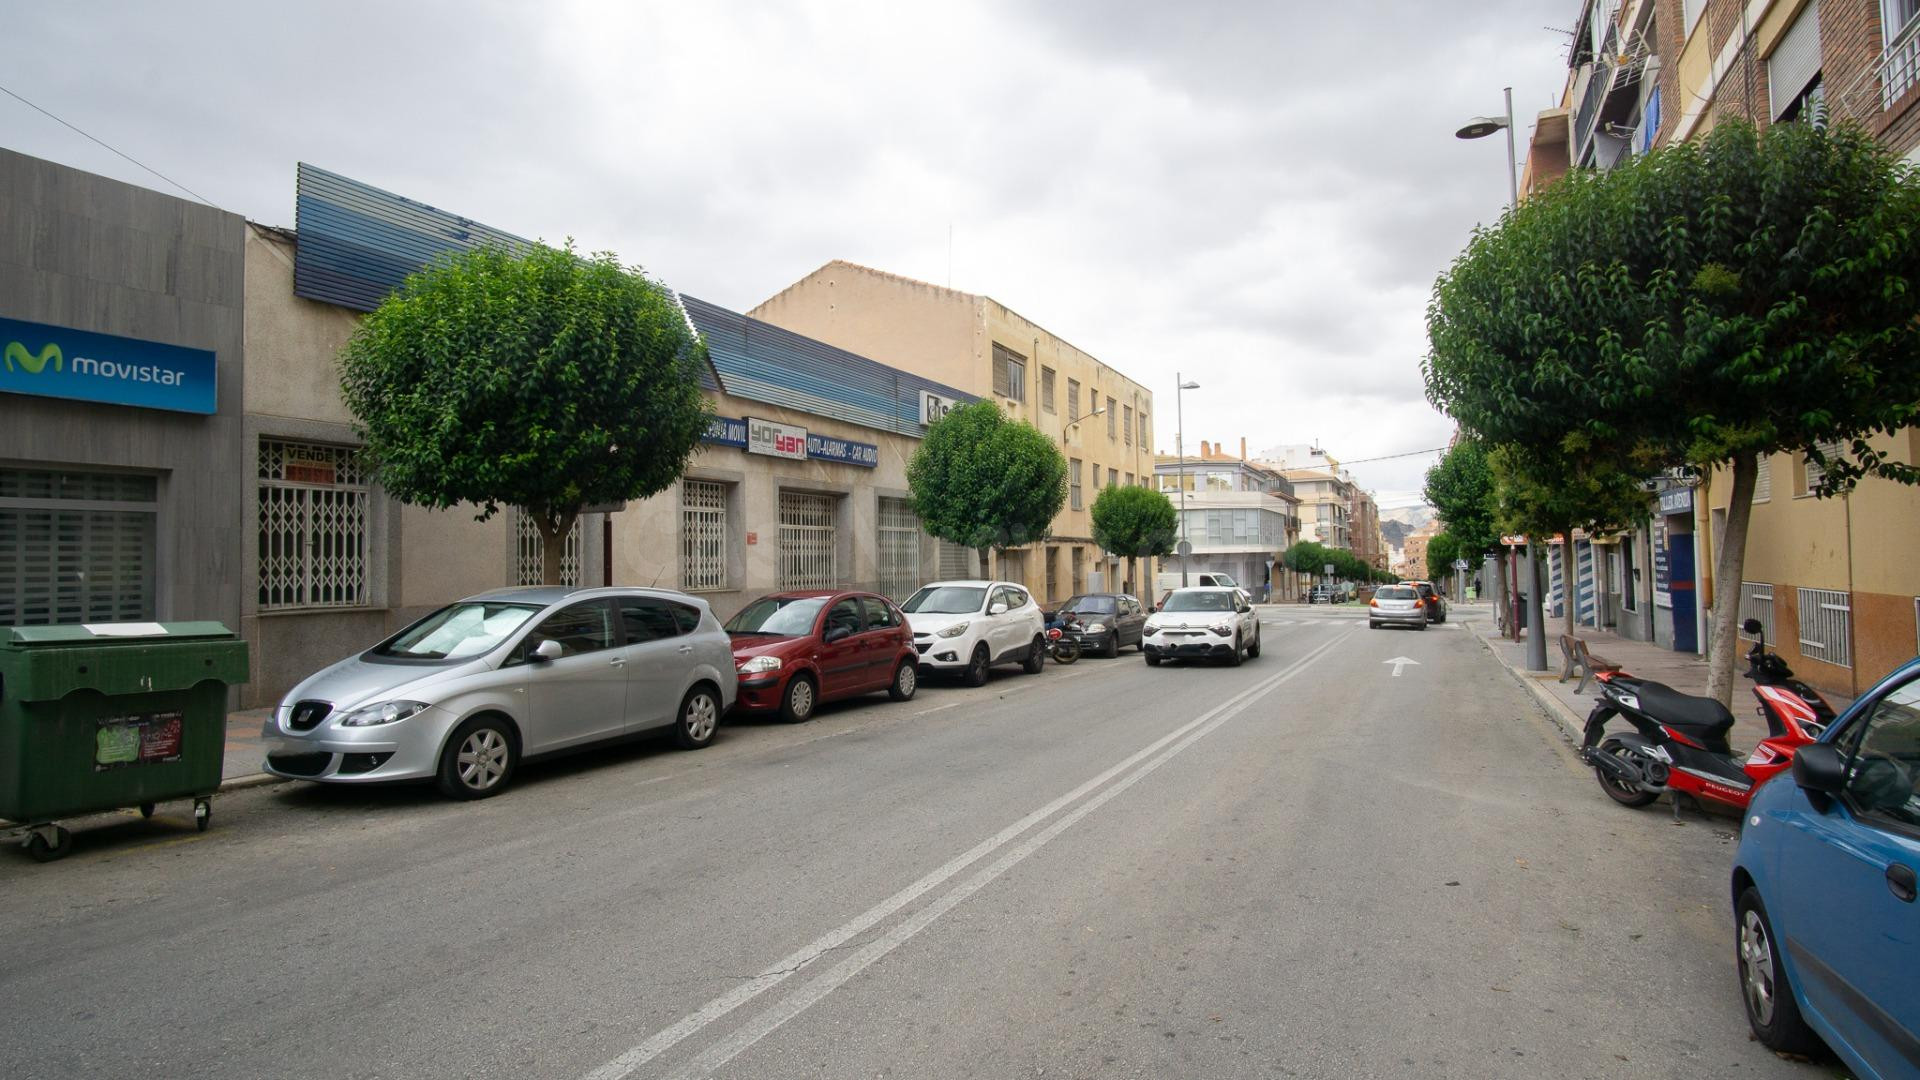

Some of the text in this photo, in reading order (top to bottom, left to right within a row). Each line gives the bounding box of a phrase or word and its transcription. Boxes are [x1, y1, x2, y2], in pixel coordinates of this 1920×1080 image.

[72, 356, 185, 386] movistar
[287, 447, 334, 463] VENDE
[1705, 782, 1745, 797] PEUGEOT
